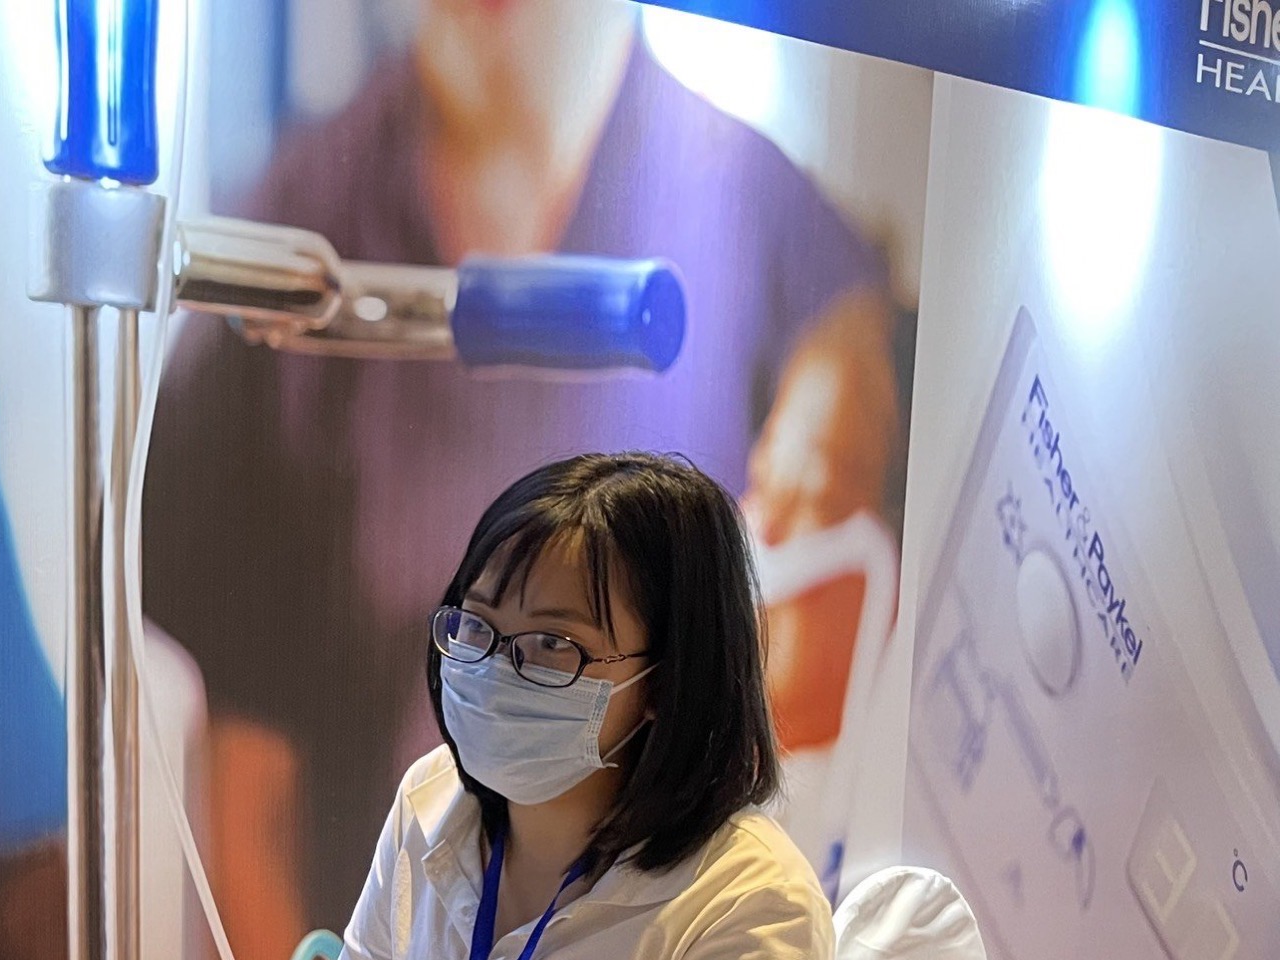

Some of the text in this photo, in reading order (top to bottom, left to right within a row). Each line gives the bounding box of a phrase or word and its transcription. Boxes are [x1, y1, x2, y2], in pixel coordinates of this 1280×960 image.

[1196, 53, 1280, 104] HEA
[1028, 373, 1080, 511] Fisher
[1087, 530, 1143, 666] Paykel
